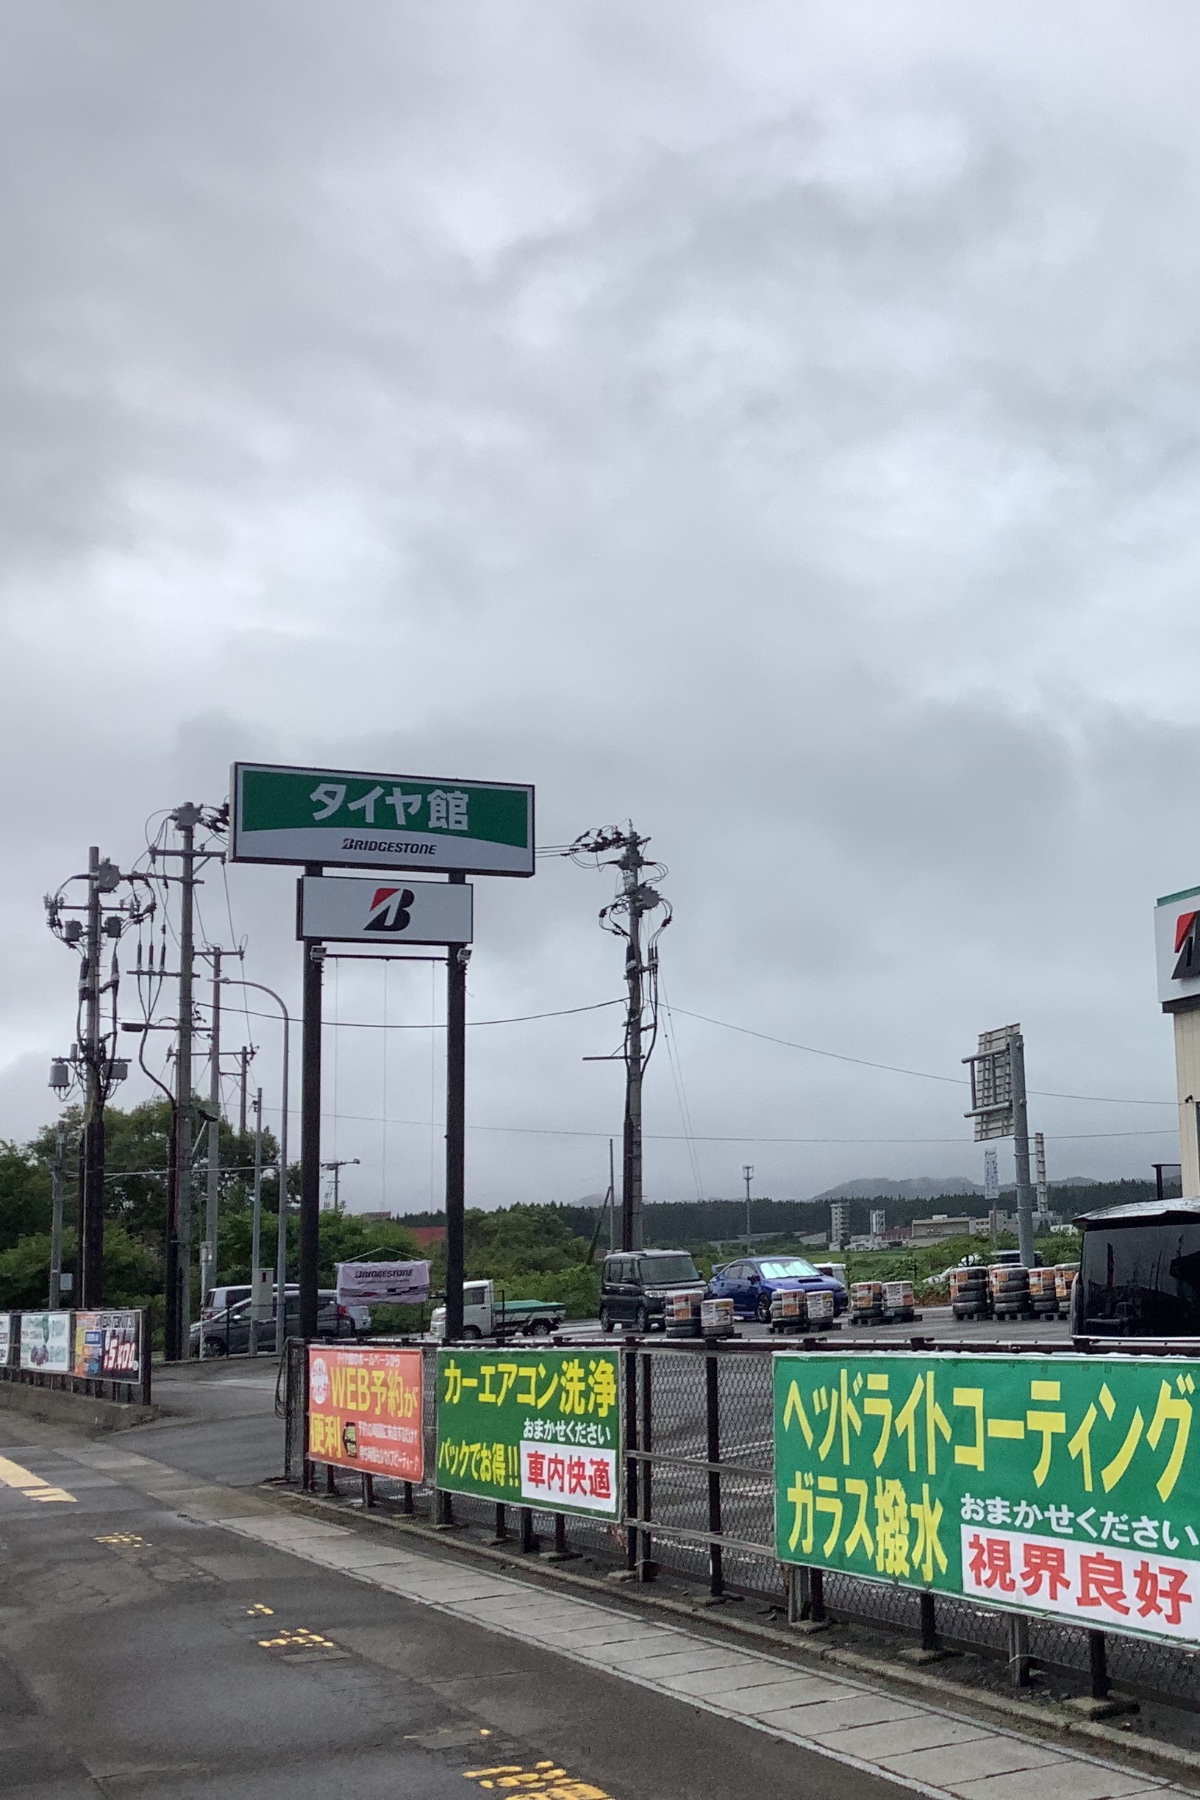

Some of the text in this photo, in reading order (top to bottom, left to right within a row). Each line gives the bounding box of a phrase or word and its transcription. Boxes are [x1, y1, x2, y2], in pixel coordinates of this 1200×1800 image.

[308, 782, 470, 831] タイヤ館
[341, 837, 438, 856] BRIDGESTONE
[330, 1366, 419, 1419] WEB予約が
[444, 1358, 616, 1417] カーエアコン洗浄
[310, 1412, 342, 1458] 便利
[523, 1417, 611, 1445] おまかせください
[783, 1368, 1196, 1502] ヘッドライトコーティング
[527, 1450, 611, 1499] 車内快適
[787, 1470, 948, 1582] ガラス撥水
[960, 1492, 1199, 1551] おまかせください
[968, 1533, 1193, 1625] 視界良好
